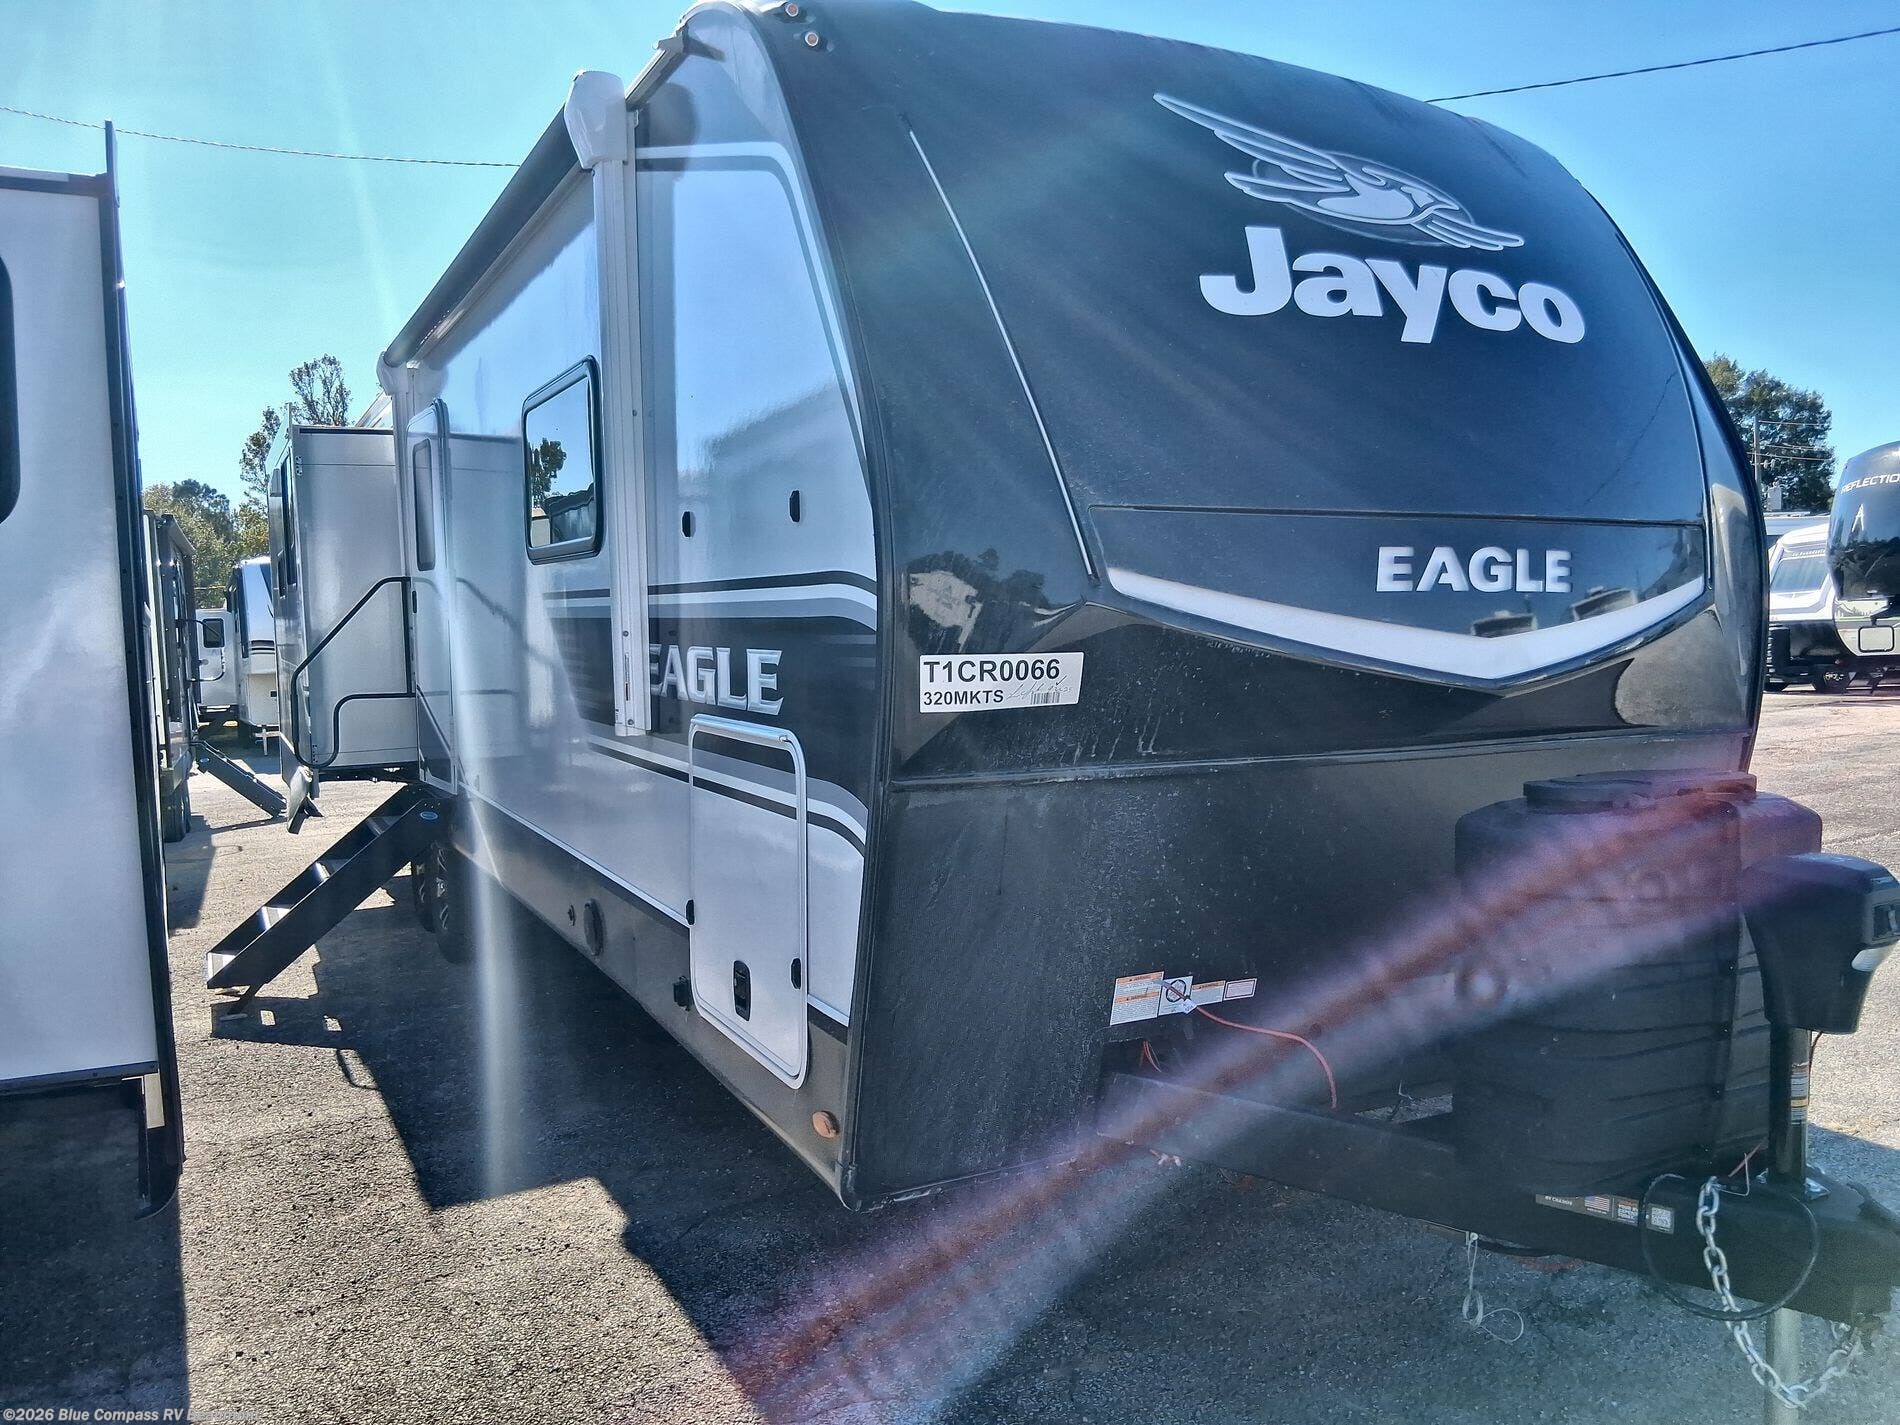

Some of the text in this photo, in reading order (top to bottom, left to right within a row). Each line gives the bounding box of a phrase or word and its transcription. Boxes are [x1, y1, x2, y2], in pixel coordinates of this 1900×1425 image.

[1199, 226, 1586, 344] Jayco
[1376, 546, 1572, 593] EAGLE
[924, 659, 1060, 683] T1CR0066
[923, 689, 1004, 706] 320MKTS
